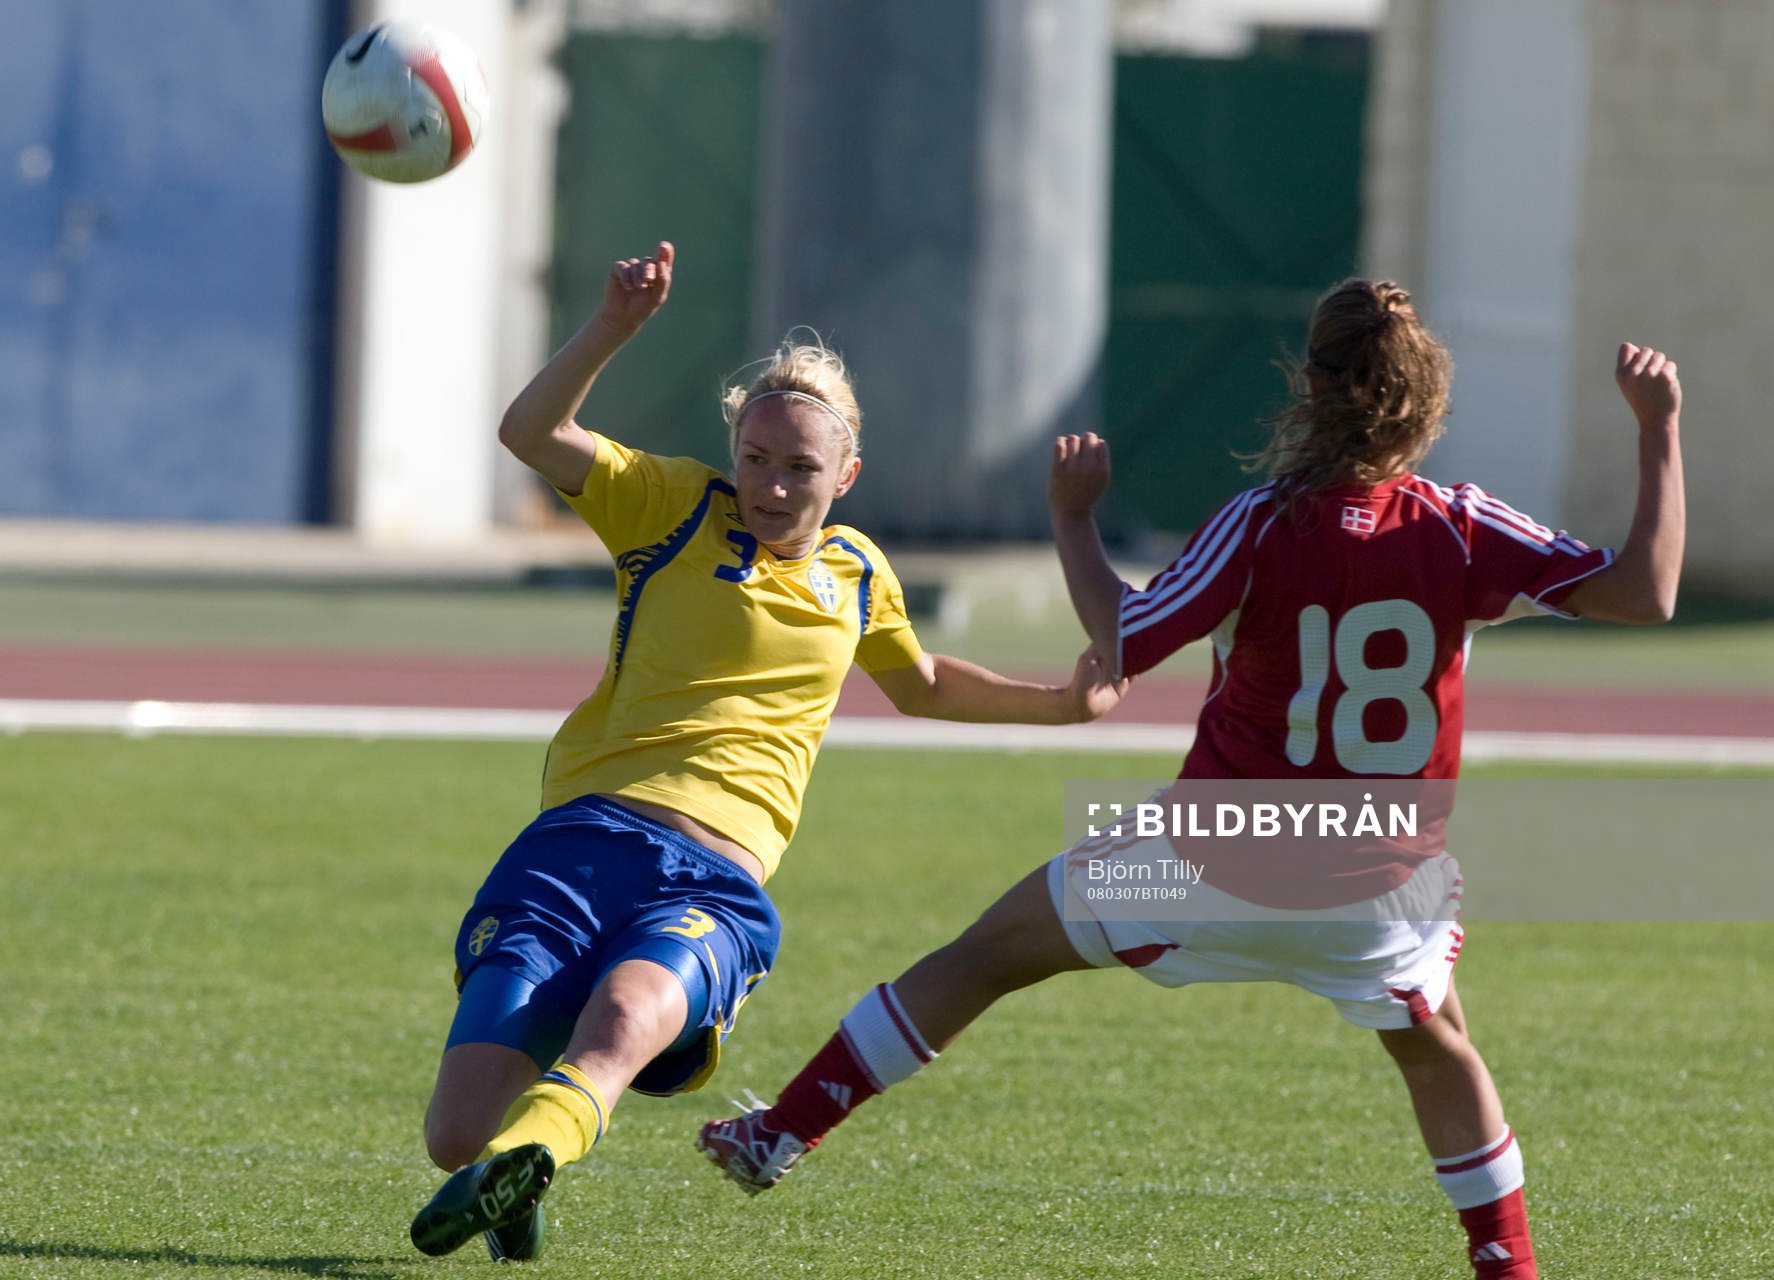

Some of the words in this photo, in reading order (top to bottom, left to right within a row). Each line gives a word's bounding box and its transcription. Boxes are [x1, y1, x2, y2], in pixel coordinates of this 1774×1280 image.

[714, 529, 758, 583] 3
[1285, 599, 1438, 775] 18
[661, 907, 717, 939] 3
